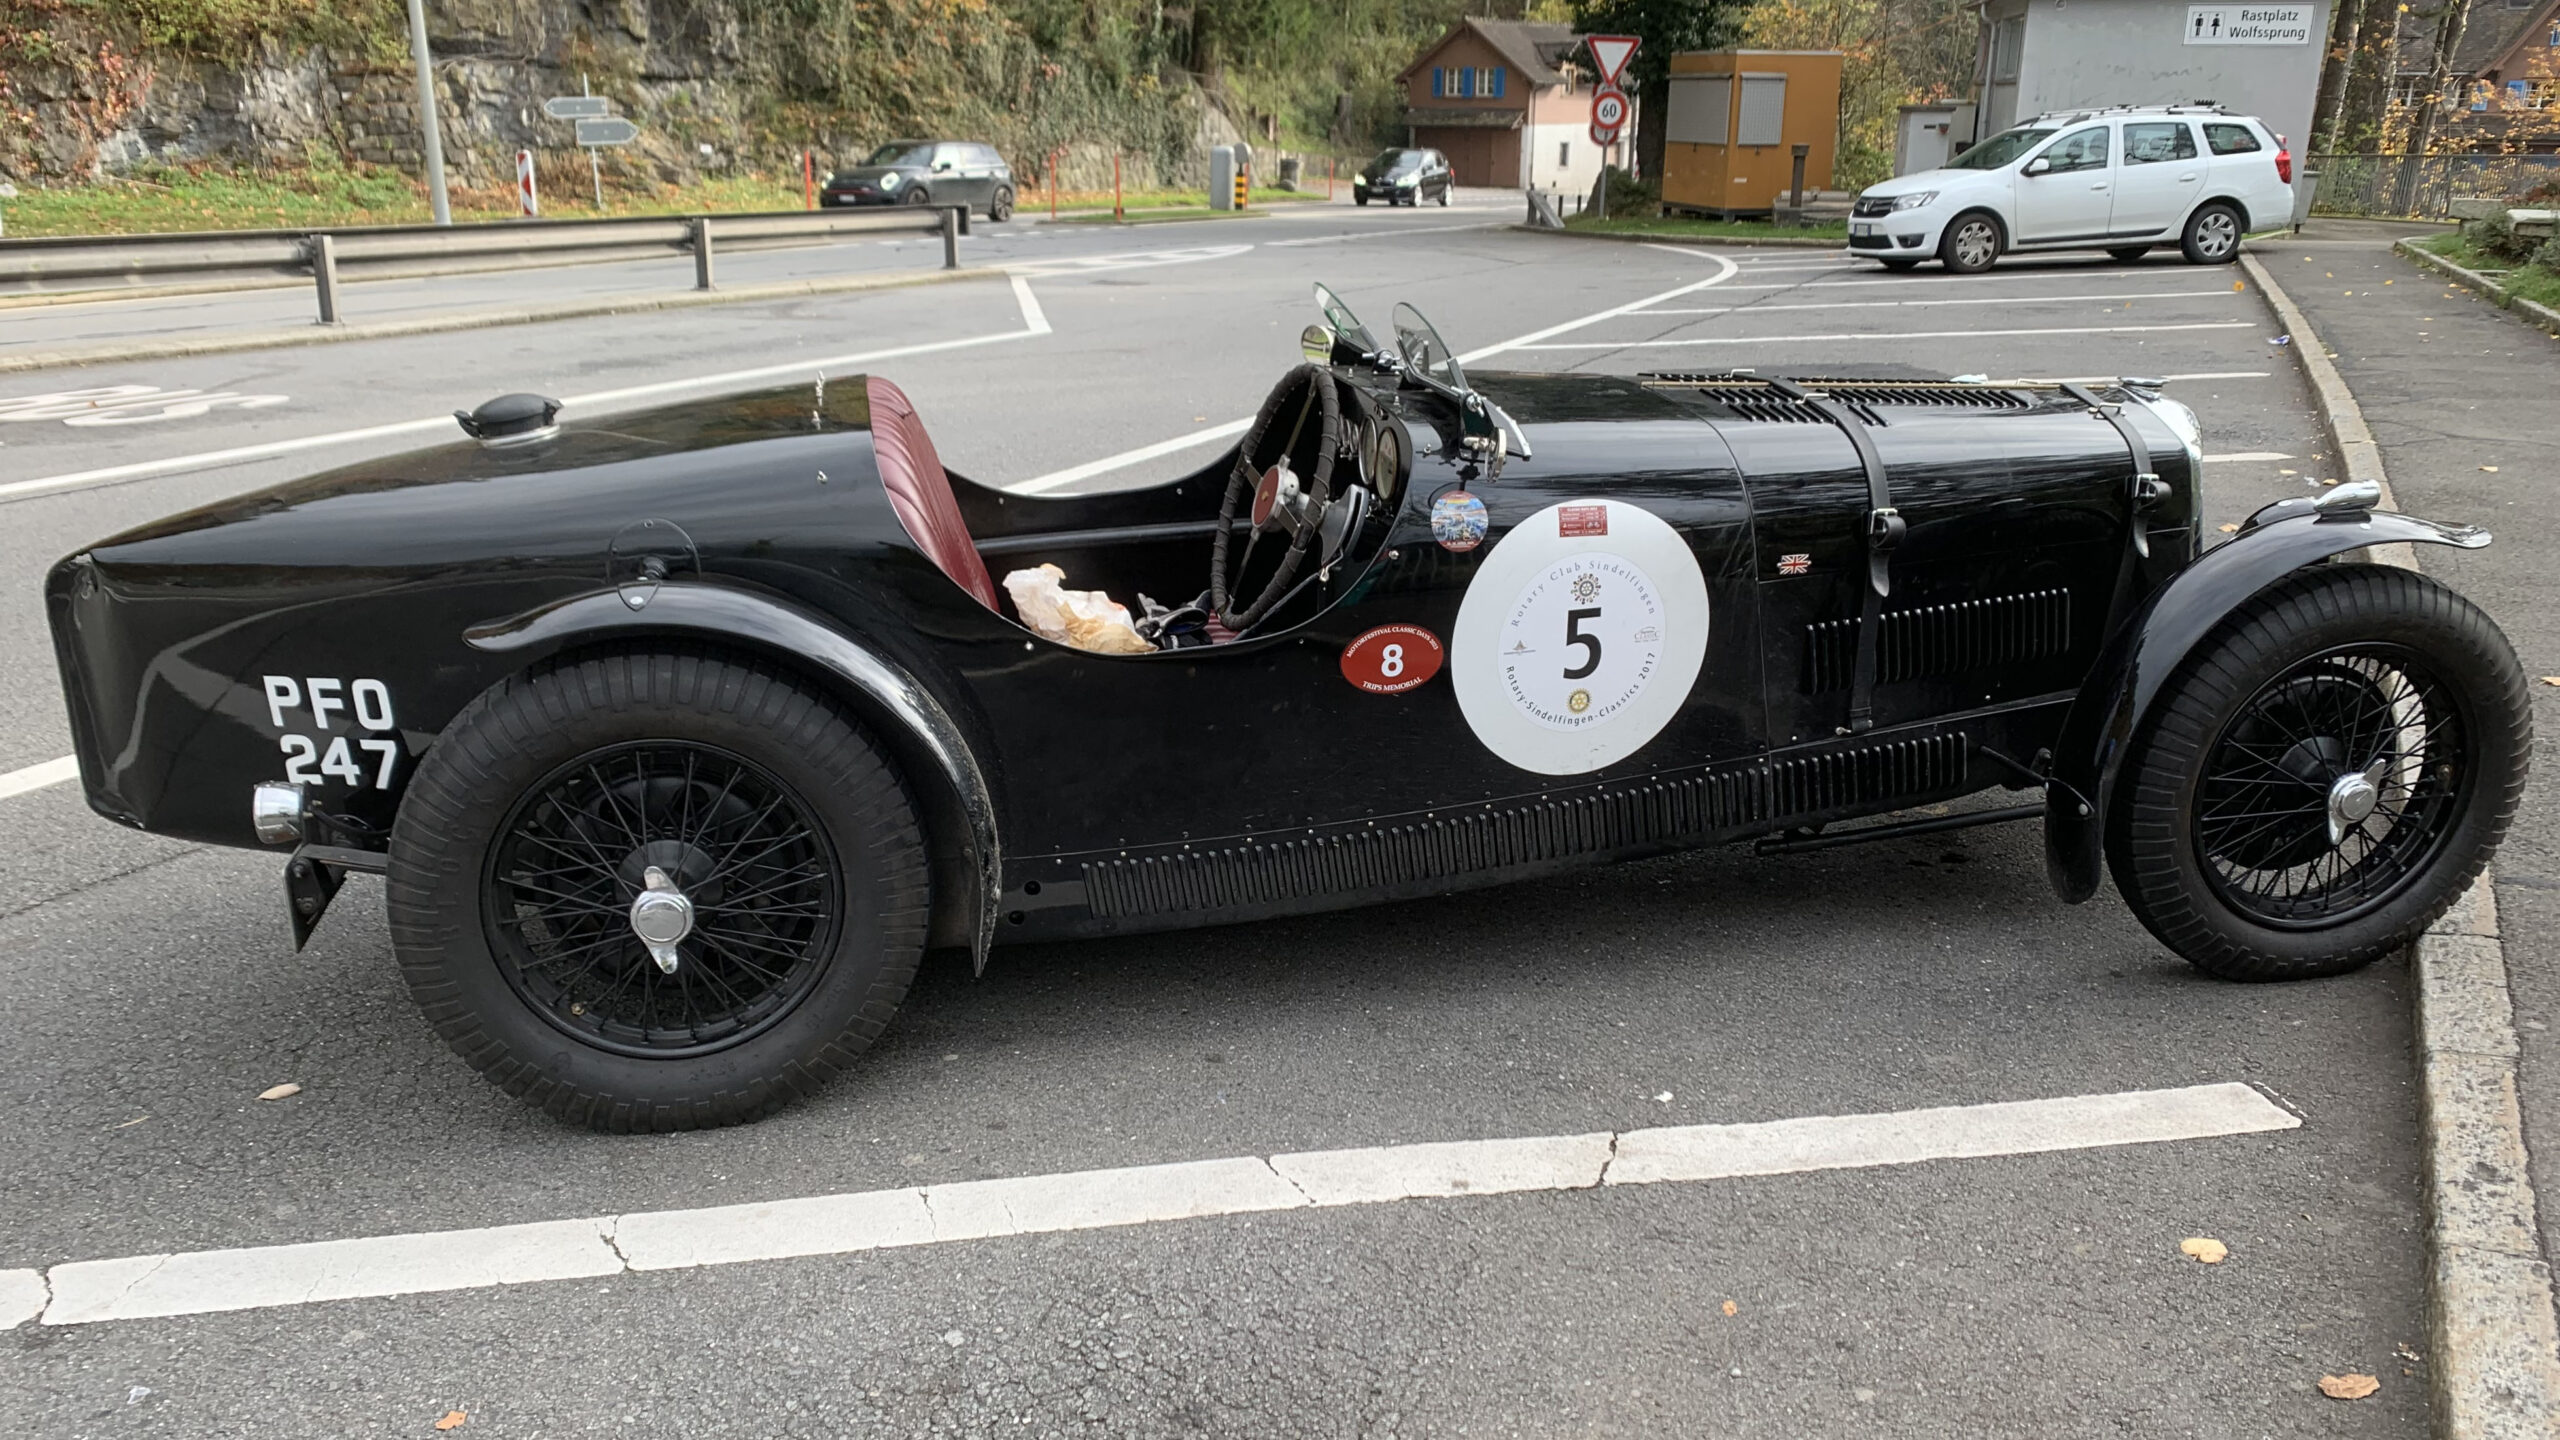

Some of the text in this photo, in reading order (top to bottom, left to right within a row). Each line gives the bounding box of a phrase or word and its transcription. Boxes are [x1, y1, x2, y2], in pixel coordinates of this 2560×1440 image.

[2229, 26, 2306, 41] Wolfssprung
[2241, 9, 2300, 24] Rastplatz
[1602, 103, 1617, 118] 60
[1511, 560, 1655, 627] Rotary Club Sindelfingen
[1346, 627, 1391, 658] MOTORFESTIVAL
[1391, 626, 1417, 635] CLASSIC
[1416, 629, 1431, 642] DAYS
[1562, 606, 1602, 680] 5
[1380, 643, 1404, 678] 8
[1362, 676, 1423, 692] TRIPS MEMORIAL
[1506, 652, 1656, 727] Rotary-Sindelfingen-Classics 2017
[262, 675, 394, 731] PFO
[279, 734, 397, 790] 247
